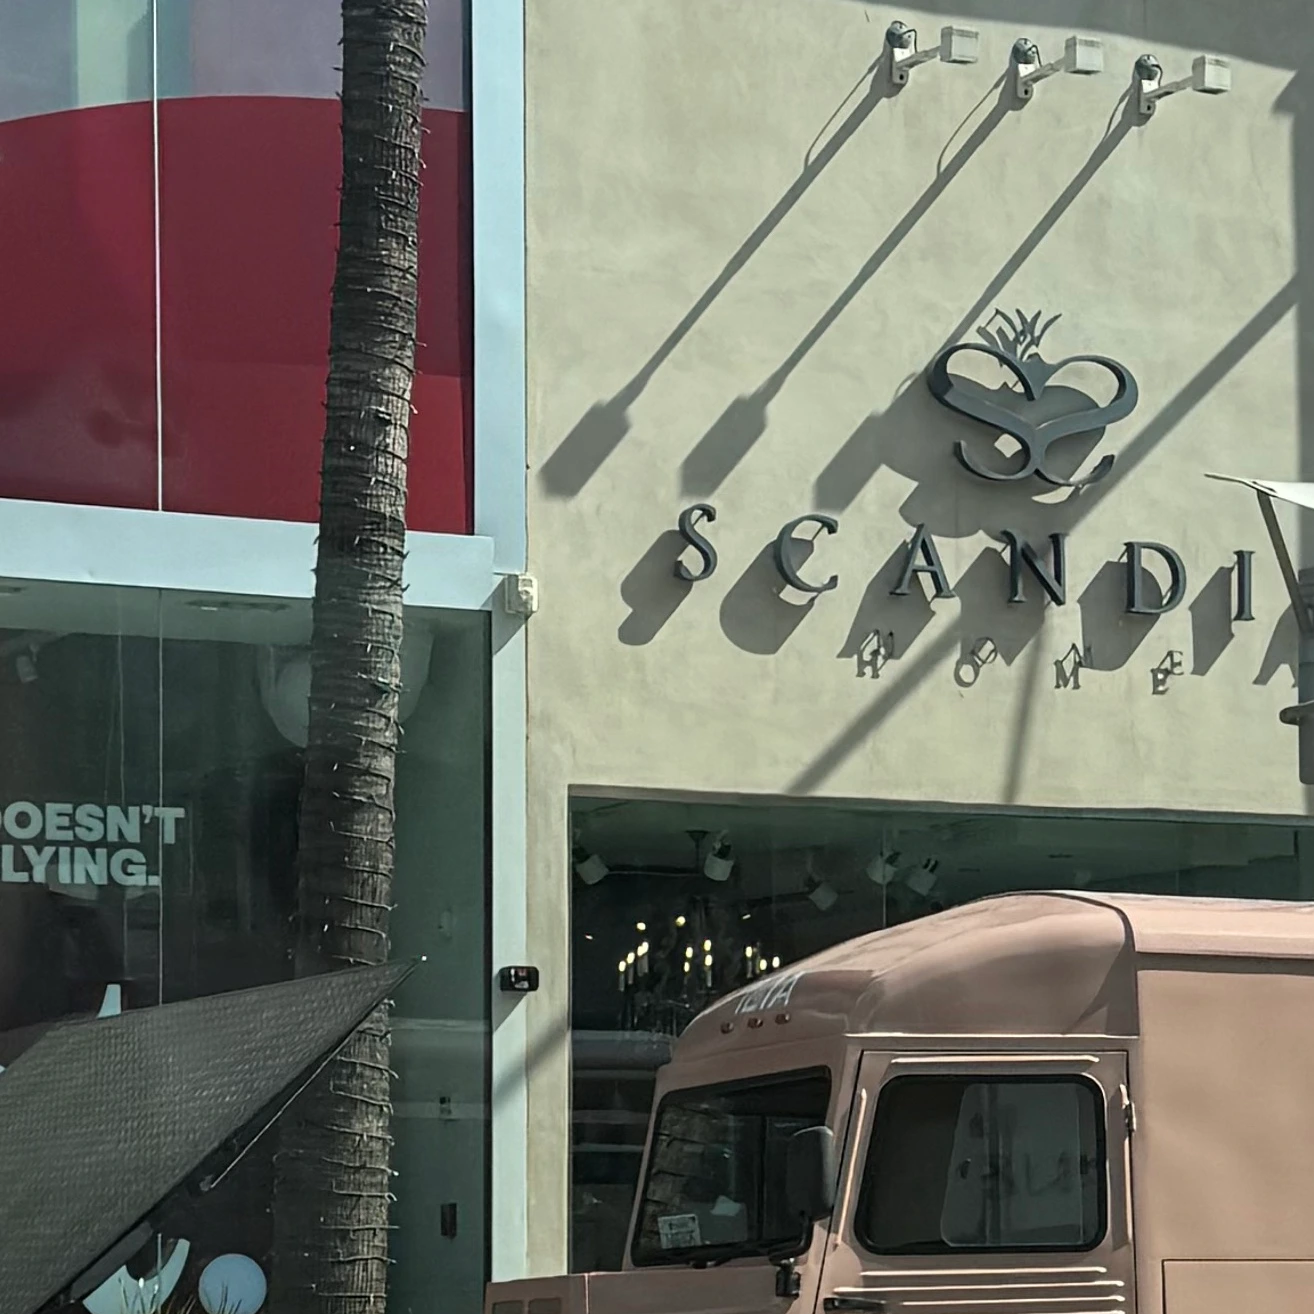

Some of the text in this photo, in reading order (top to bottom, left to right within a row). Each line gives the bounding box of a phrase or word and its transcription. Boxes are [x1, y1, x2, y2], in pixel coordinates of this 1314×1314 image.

[674, 503, 1255, 621] SCANDI
[856, 629, 1184, 695] HOME
[0, 801, 185, 844] OESN'T
[1, 845, 160, 886] LYING.
